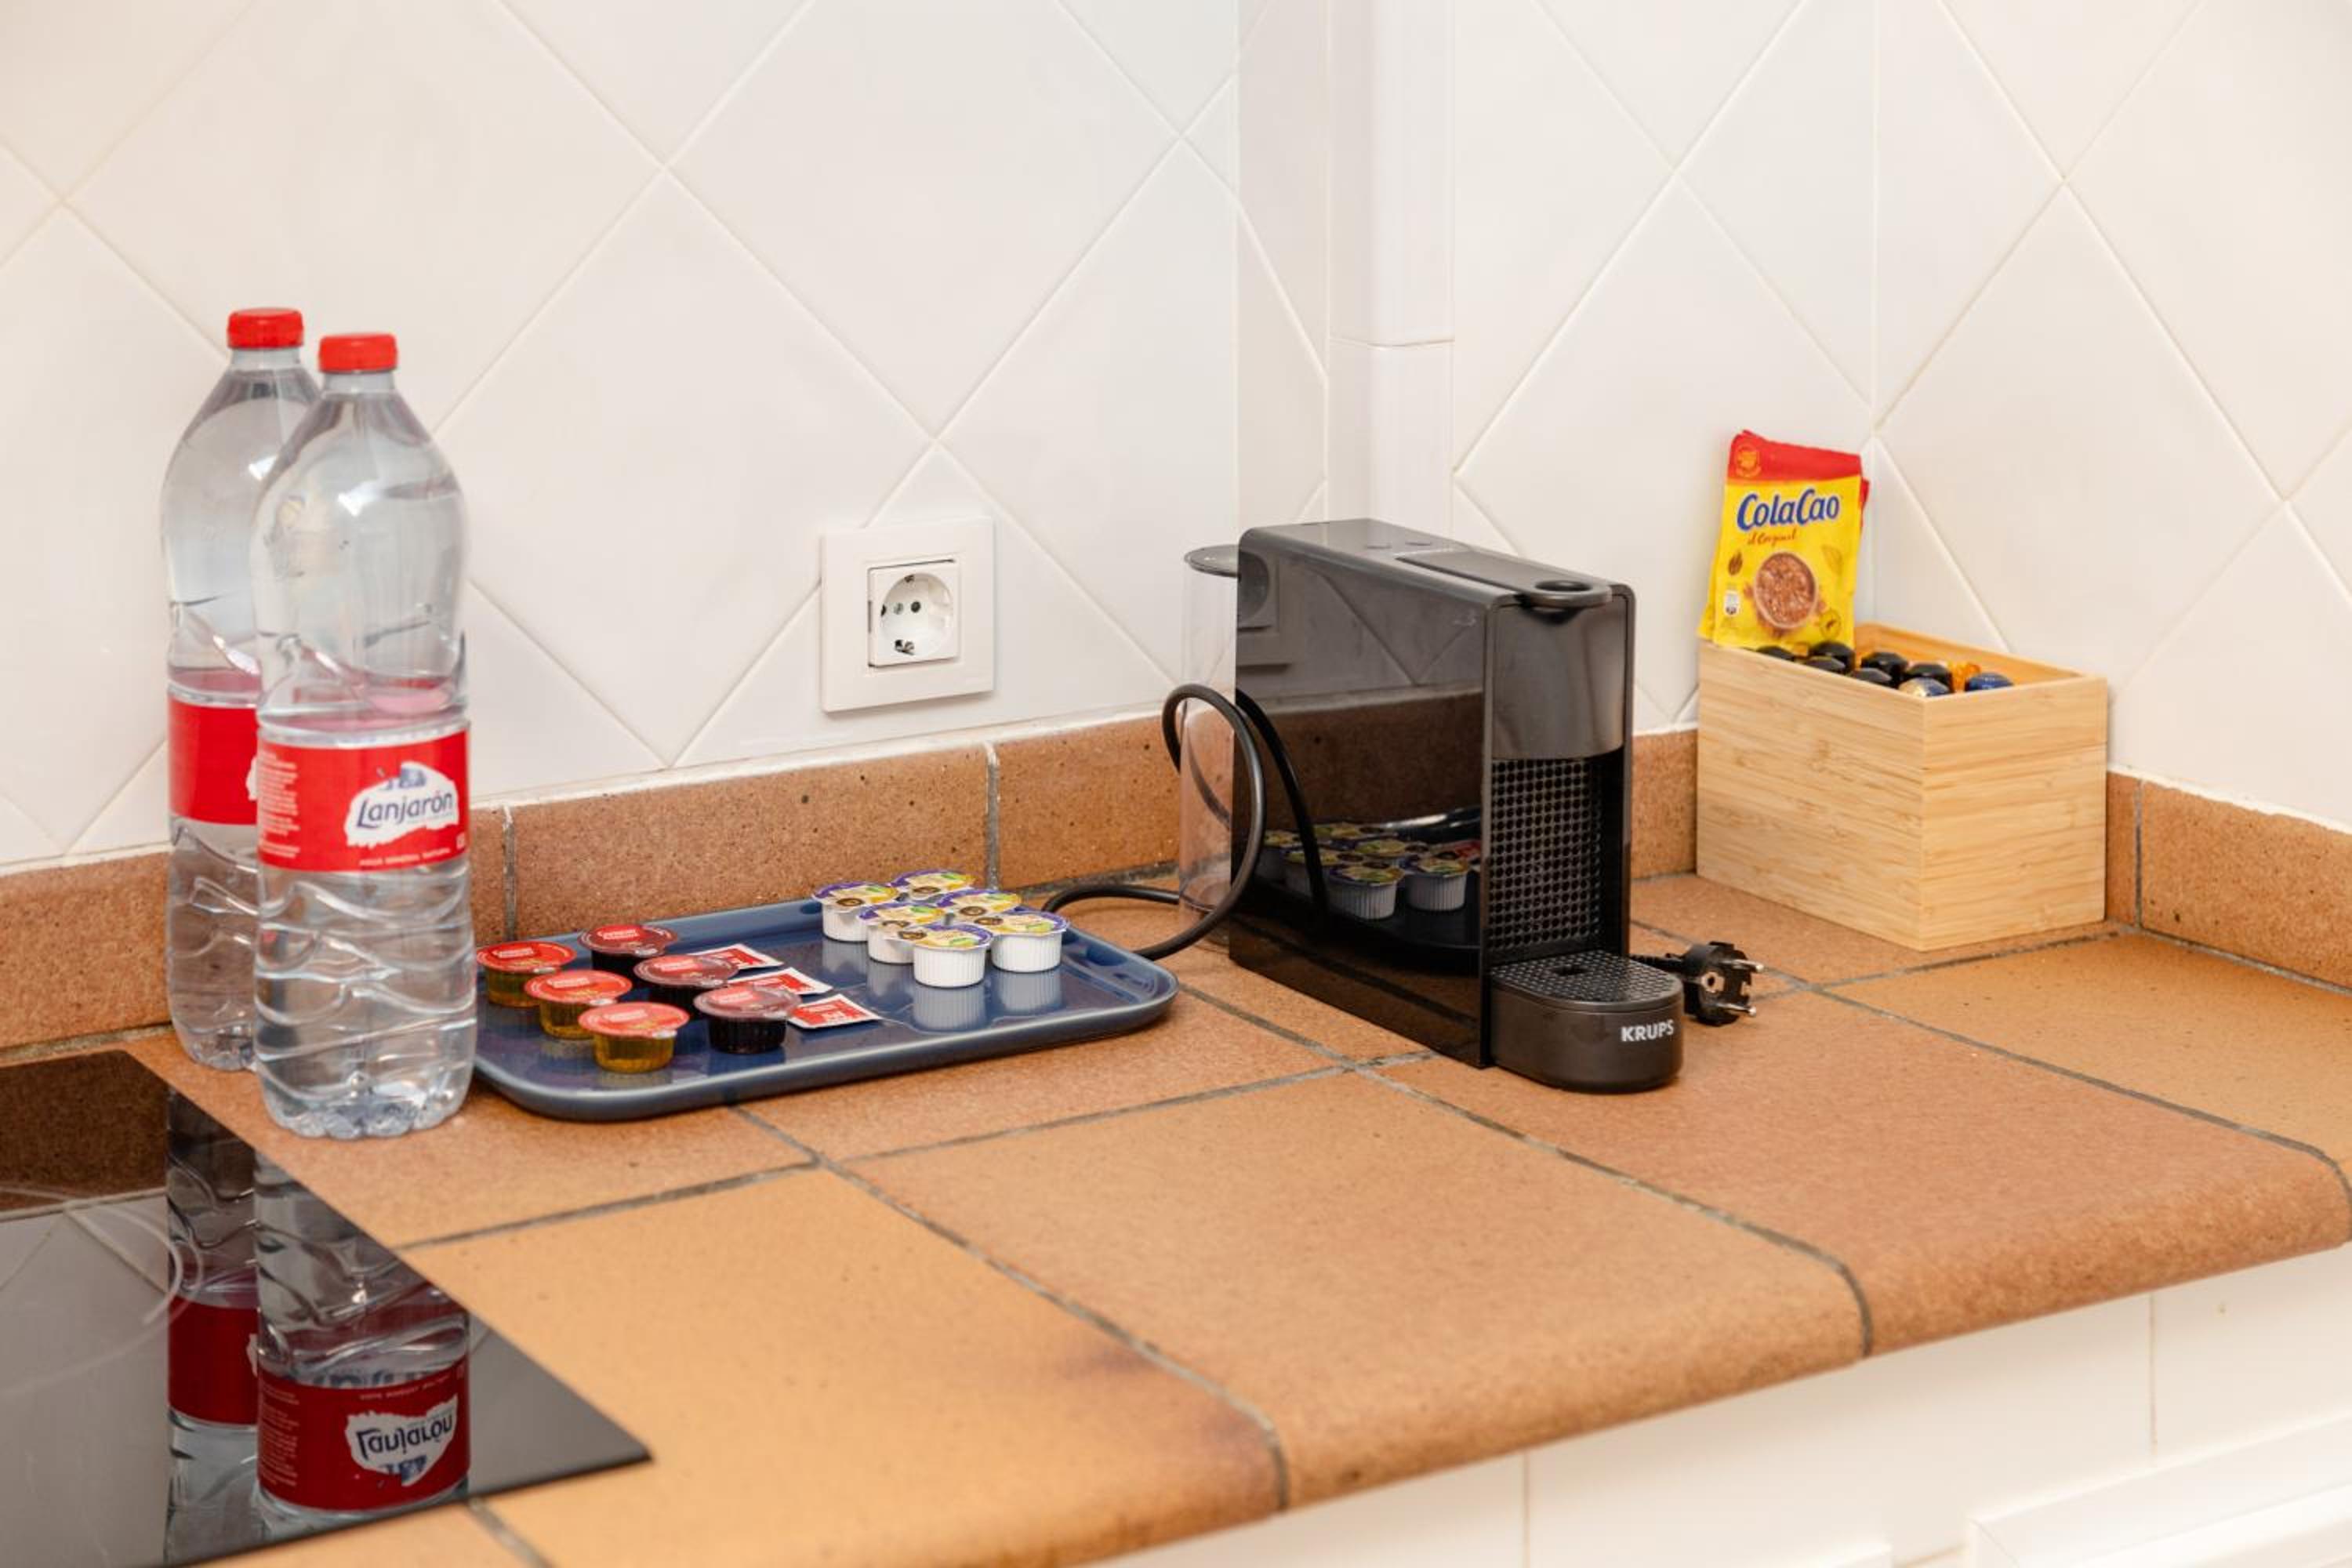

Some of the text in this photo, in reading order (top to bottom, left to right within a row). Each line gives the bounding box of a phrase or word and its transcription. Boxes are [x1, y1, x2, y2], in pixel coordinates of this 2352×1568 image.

[1737, 488, 1840, 531] ColaCao
[356, 790, 453, 829] Lanjarón
[1621, 1018, 1674, 1042] KRUPS
